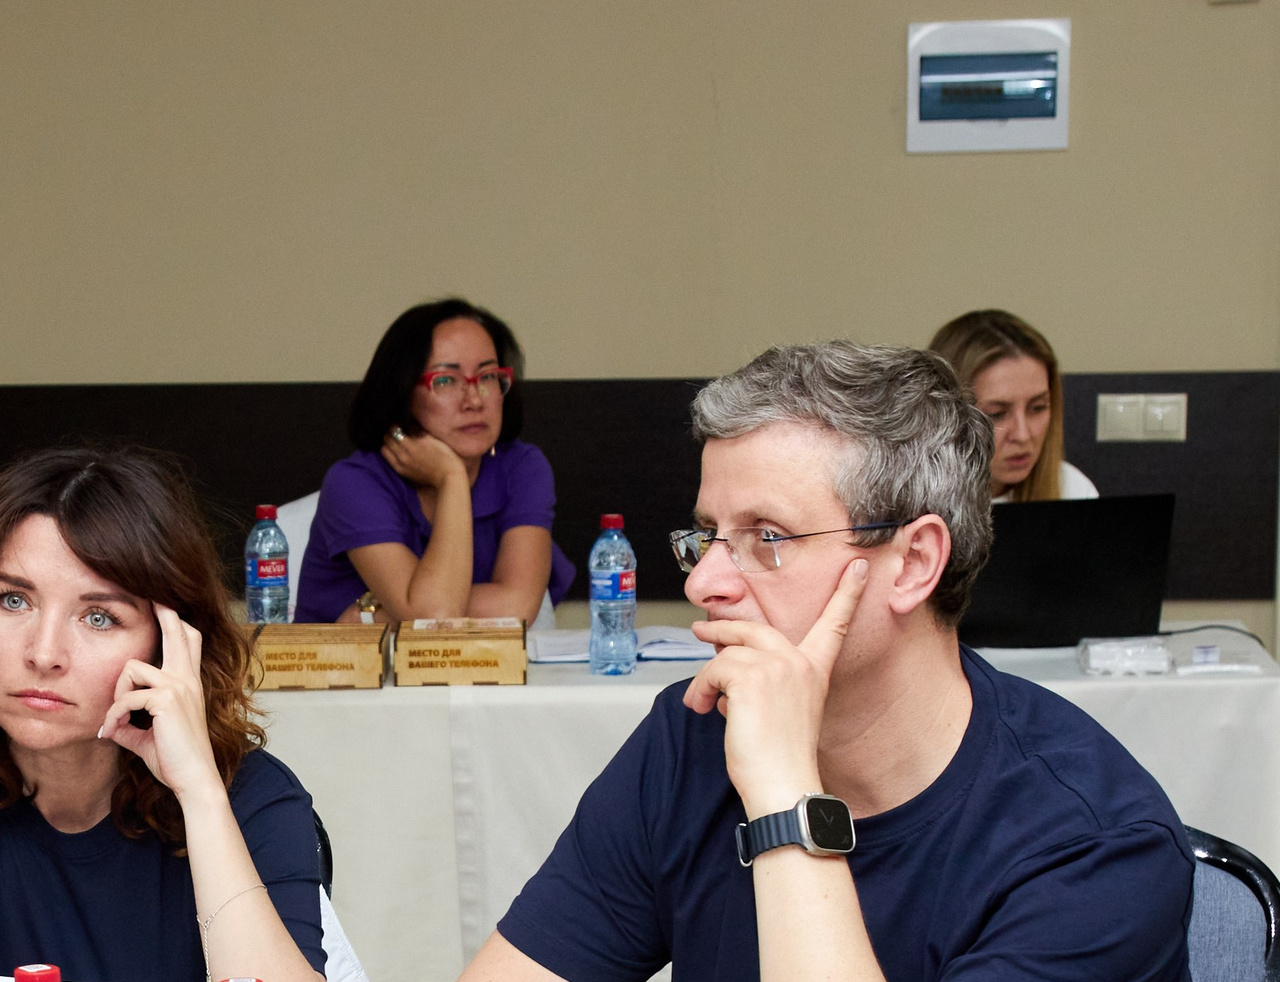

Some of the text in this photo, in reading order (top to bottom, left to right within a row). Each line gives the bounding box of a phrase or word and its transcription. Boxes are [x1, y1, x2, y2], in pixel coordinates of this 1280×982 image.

[265, 651, 318, 662] МЕСТО ДЛЯ
[408, 648, 461, 658] МЕСТО ДЛЯ
[265, 662, 356, 672] ВАШЕГО ТЕЛЕФОНА
[408, 659, 500, 669] ВАШЕГО ТЕЛЕФОНА
